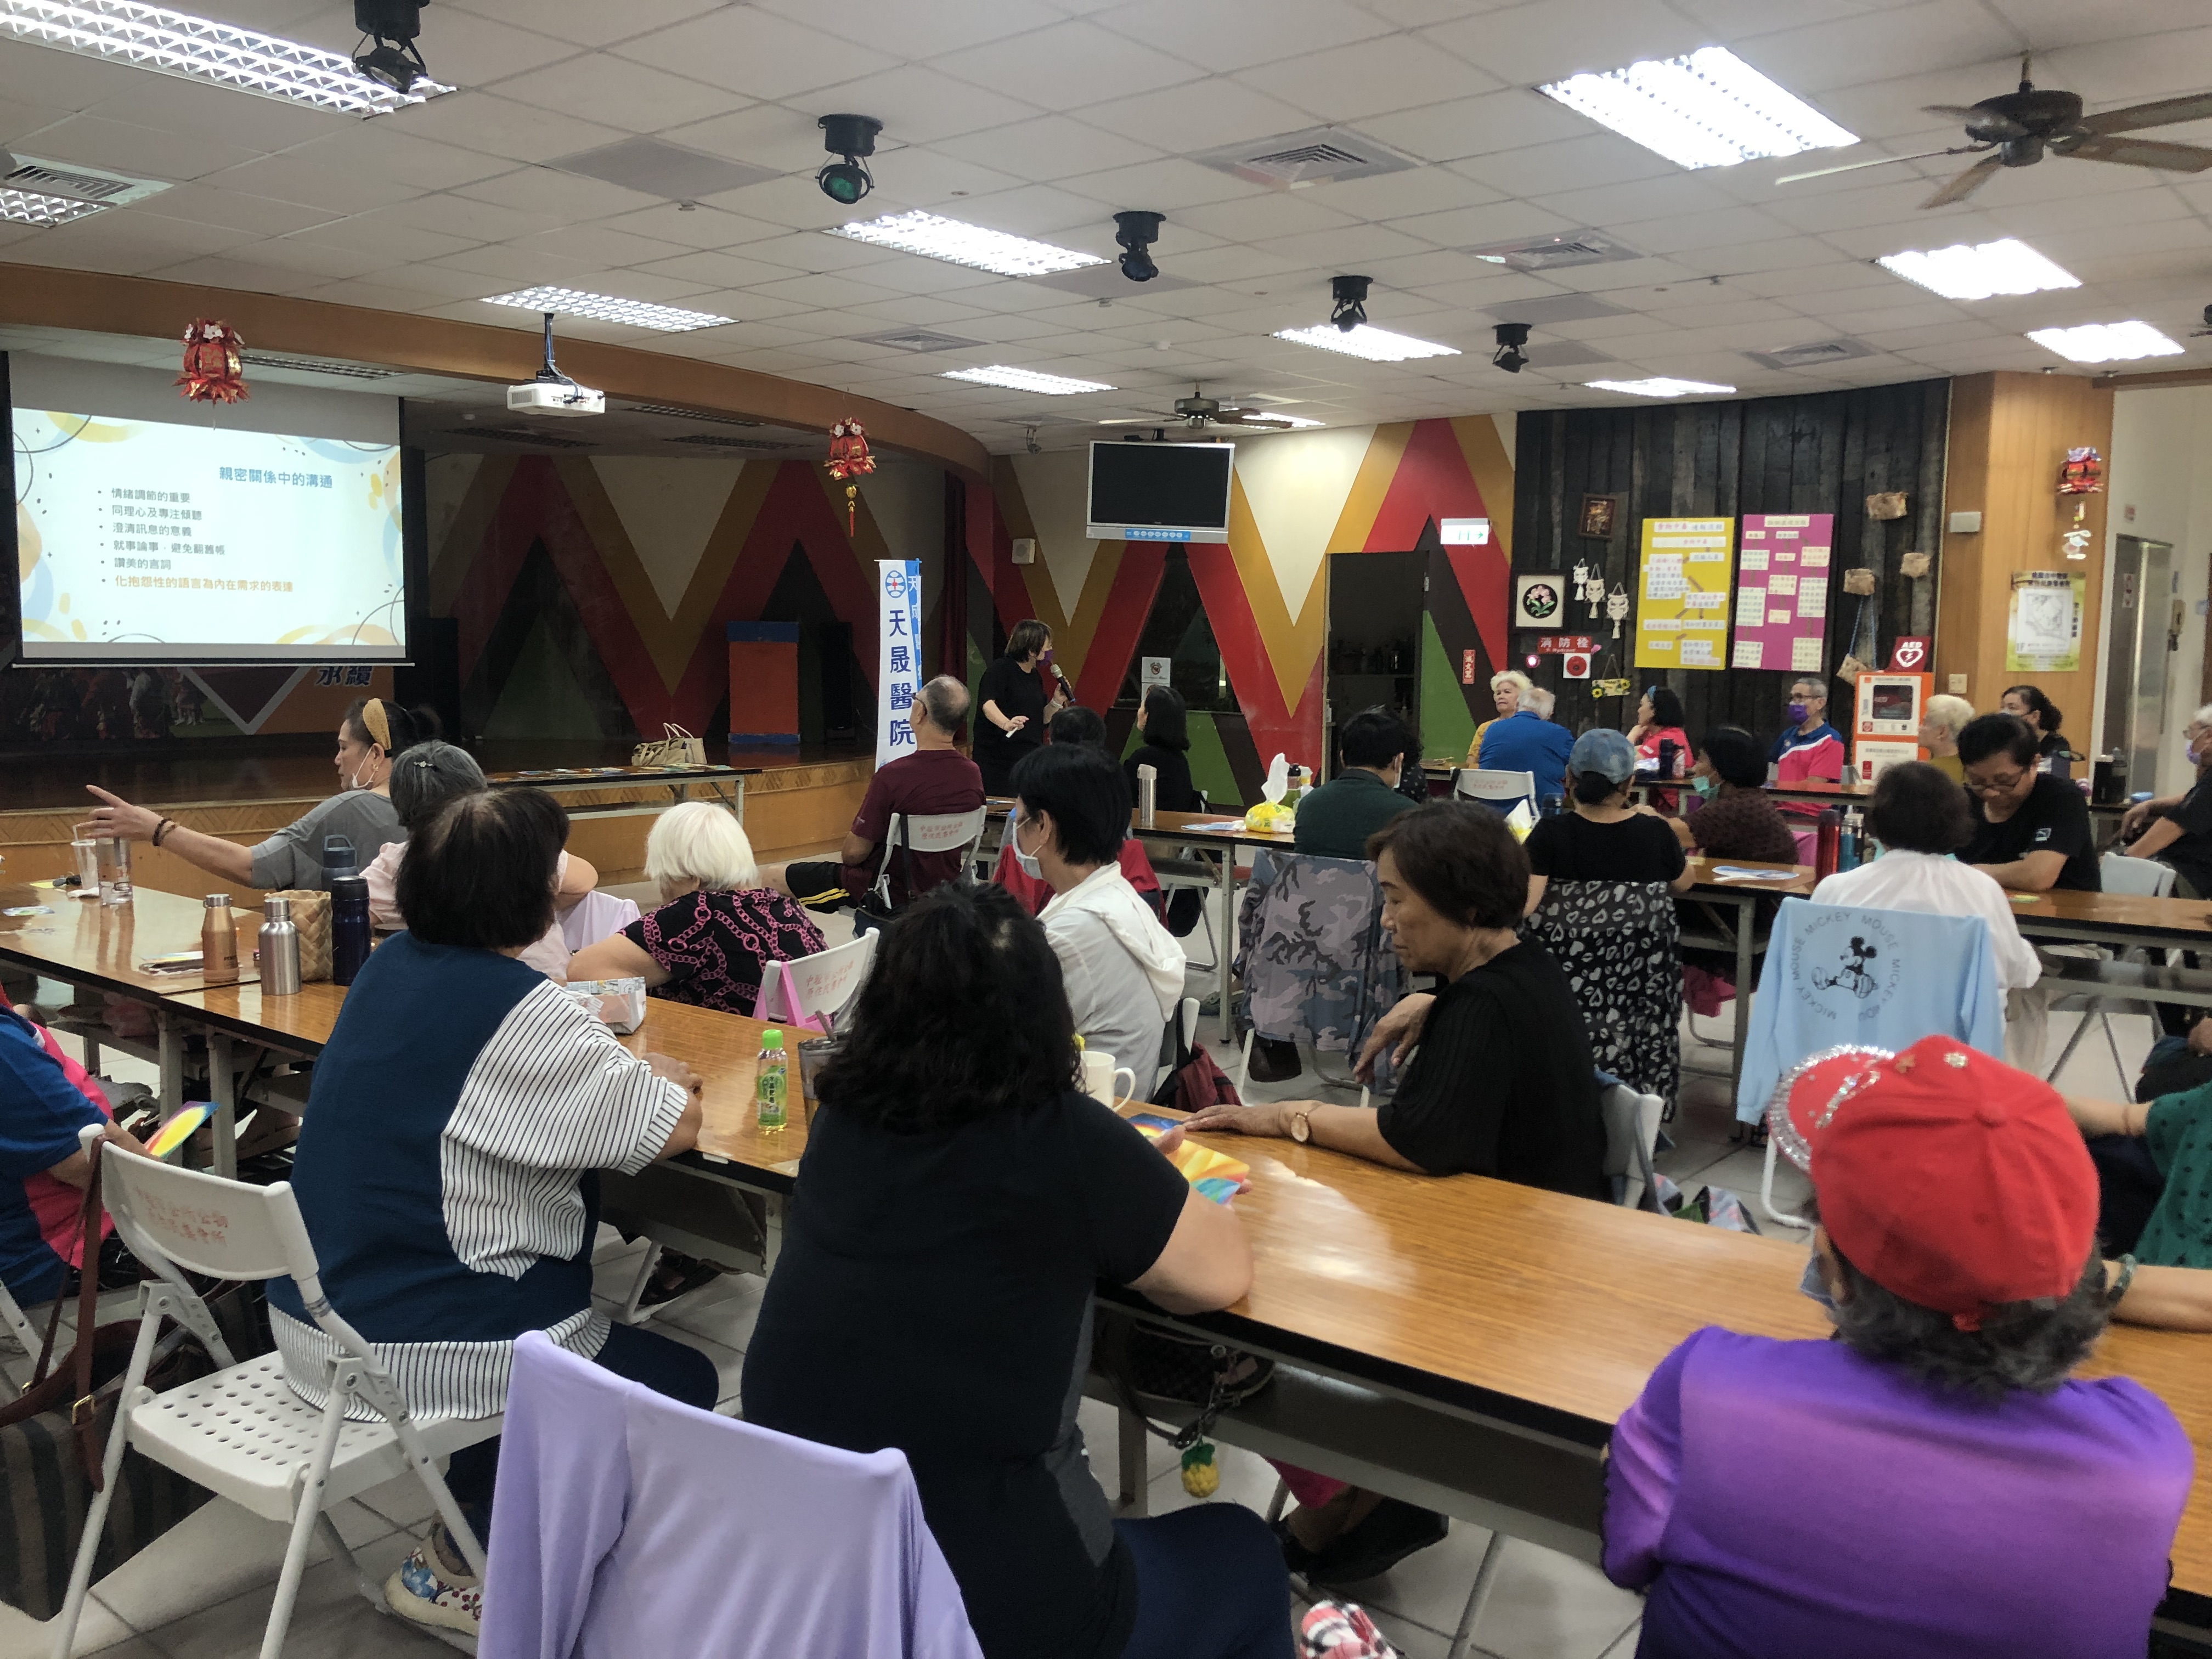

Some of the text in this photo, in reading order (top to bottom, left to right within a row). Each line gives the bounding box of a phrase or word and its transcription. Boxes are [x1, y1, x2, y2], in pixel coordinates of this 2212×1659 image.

[219, 467, 332, 488] 親密關係中的溝通
[111, 488, 190, 503] 情緒調節的重要
[112, 505, 202, 521] 同理心及專注傾聽
[112, 522, 191, 537] 澄清訊息的意義
[115, 557, 171, 570] 讚美的言詞
[115, 575, 293, 592] 化抱怨性的語言為內在需求的表達
[1541, 637, 1588, 647] 消防栓
[889, 610, 915, 747] 天晟醫院
[1805, 912, 1851, 935] MICKEY
[1861, 915, 1898, 950] MOUSE
[1790, 937, 1805, 980] MOUSE
[1881, 958, 1900, 1005] MICKEY
[1796, 987, 1836, 1020] MICKEY
